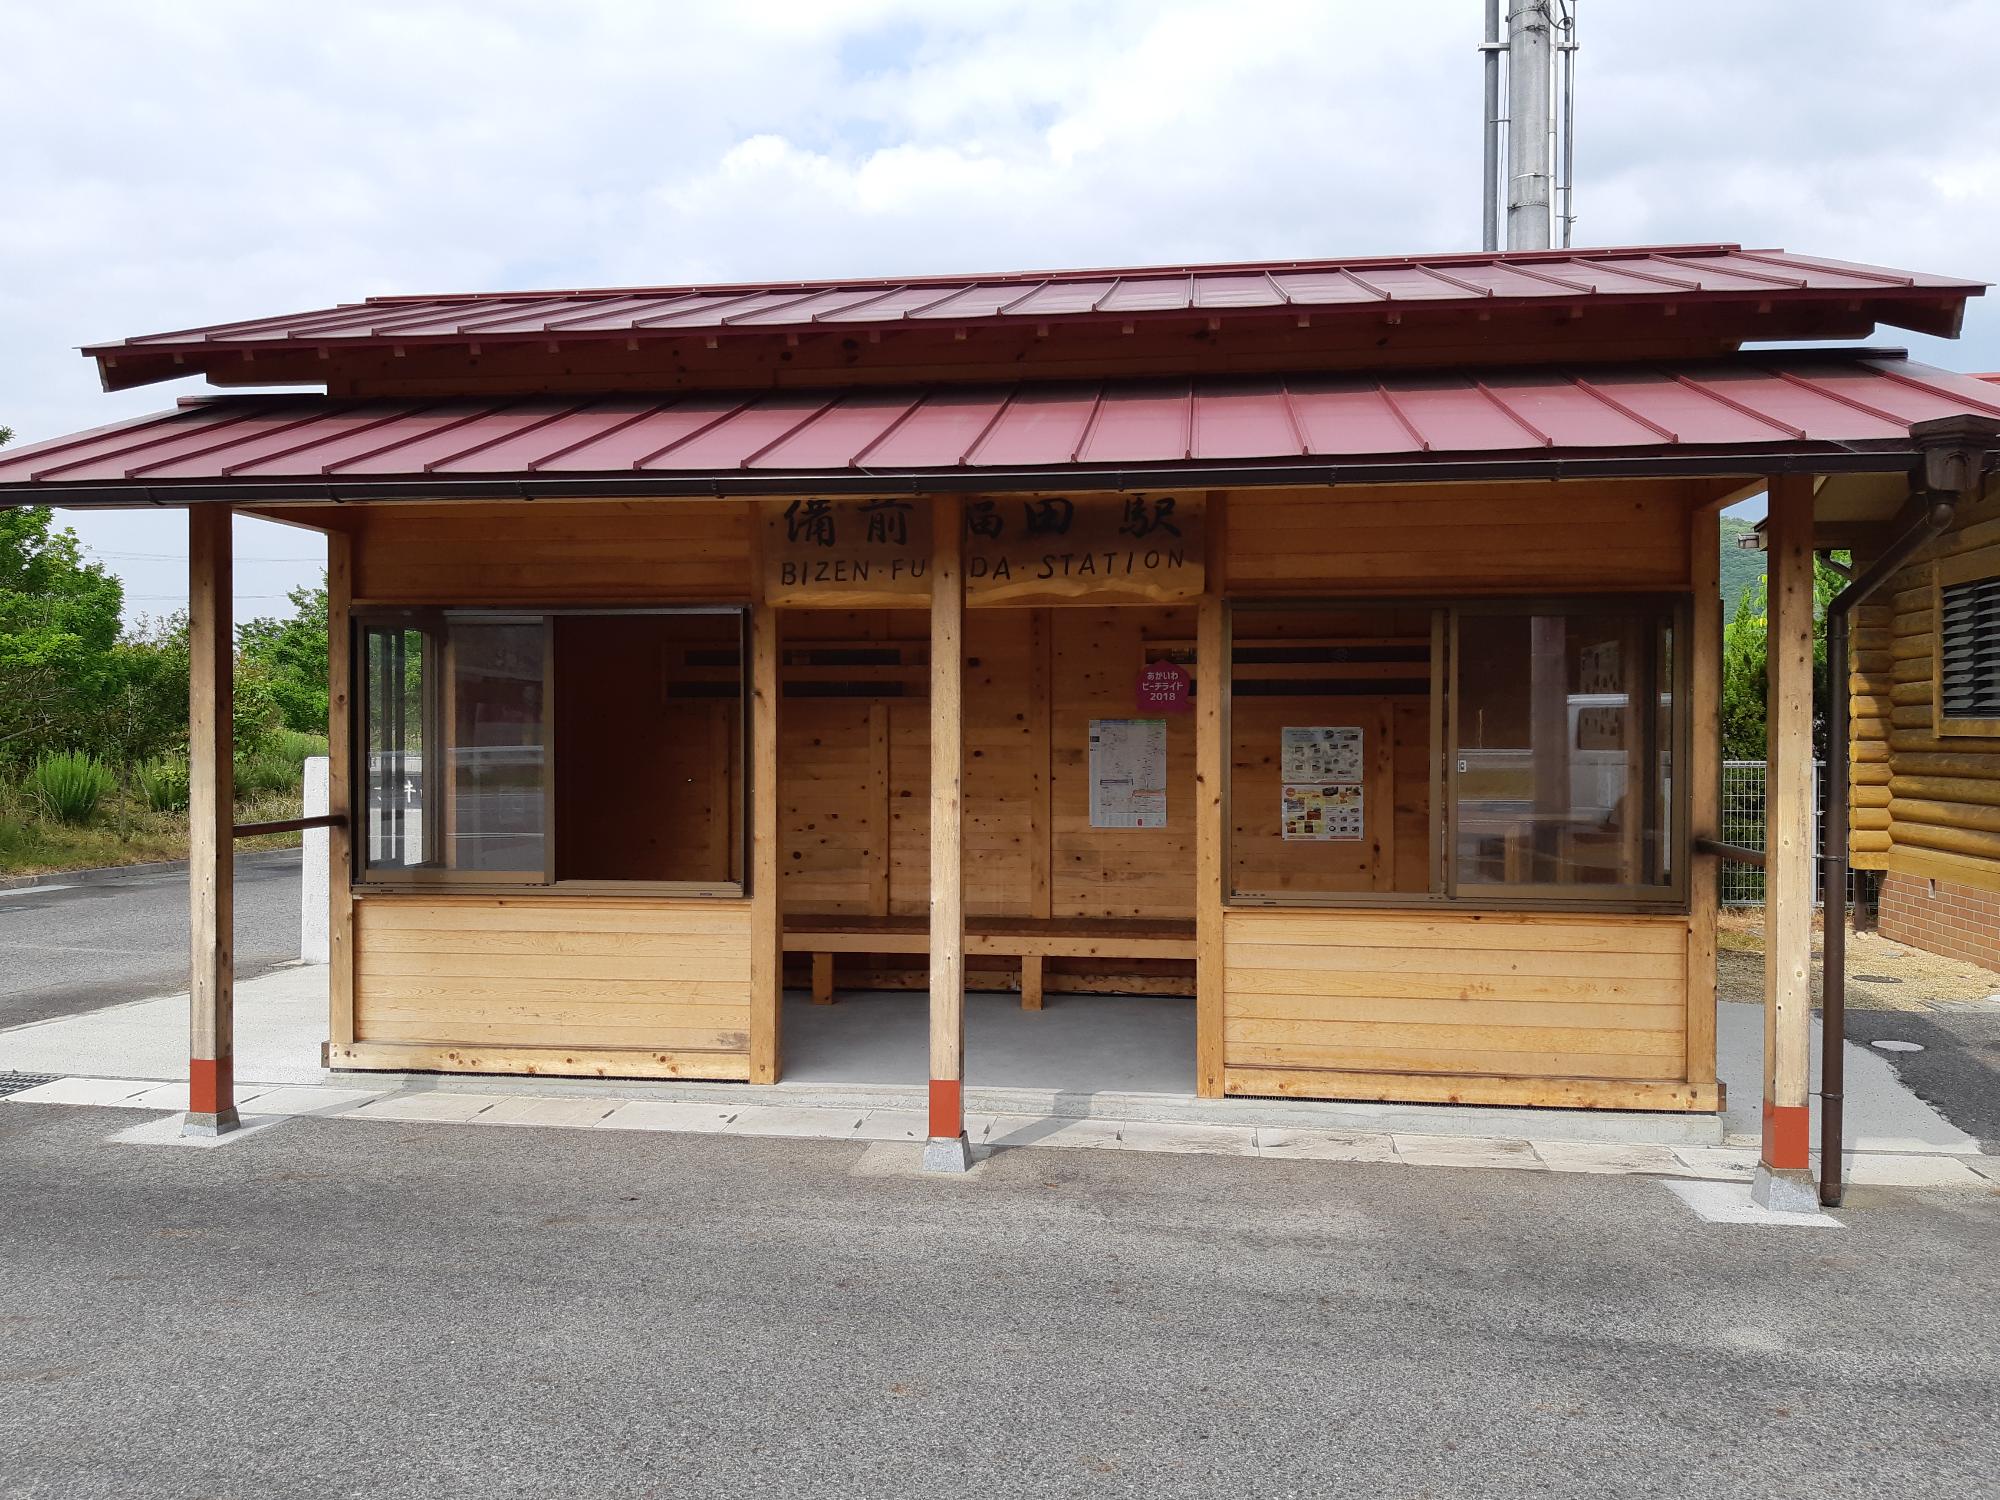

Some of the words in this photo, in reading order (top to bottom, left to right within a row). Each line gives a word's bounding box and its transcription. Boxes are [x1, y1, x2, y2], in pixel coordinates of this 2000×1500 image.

[1146, 671, 1179, 681] あかいわ
[1150, 692, 1176, 701] 2018
